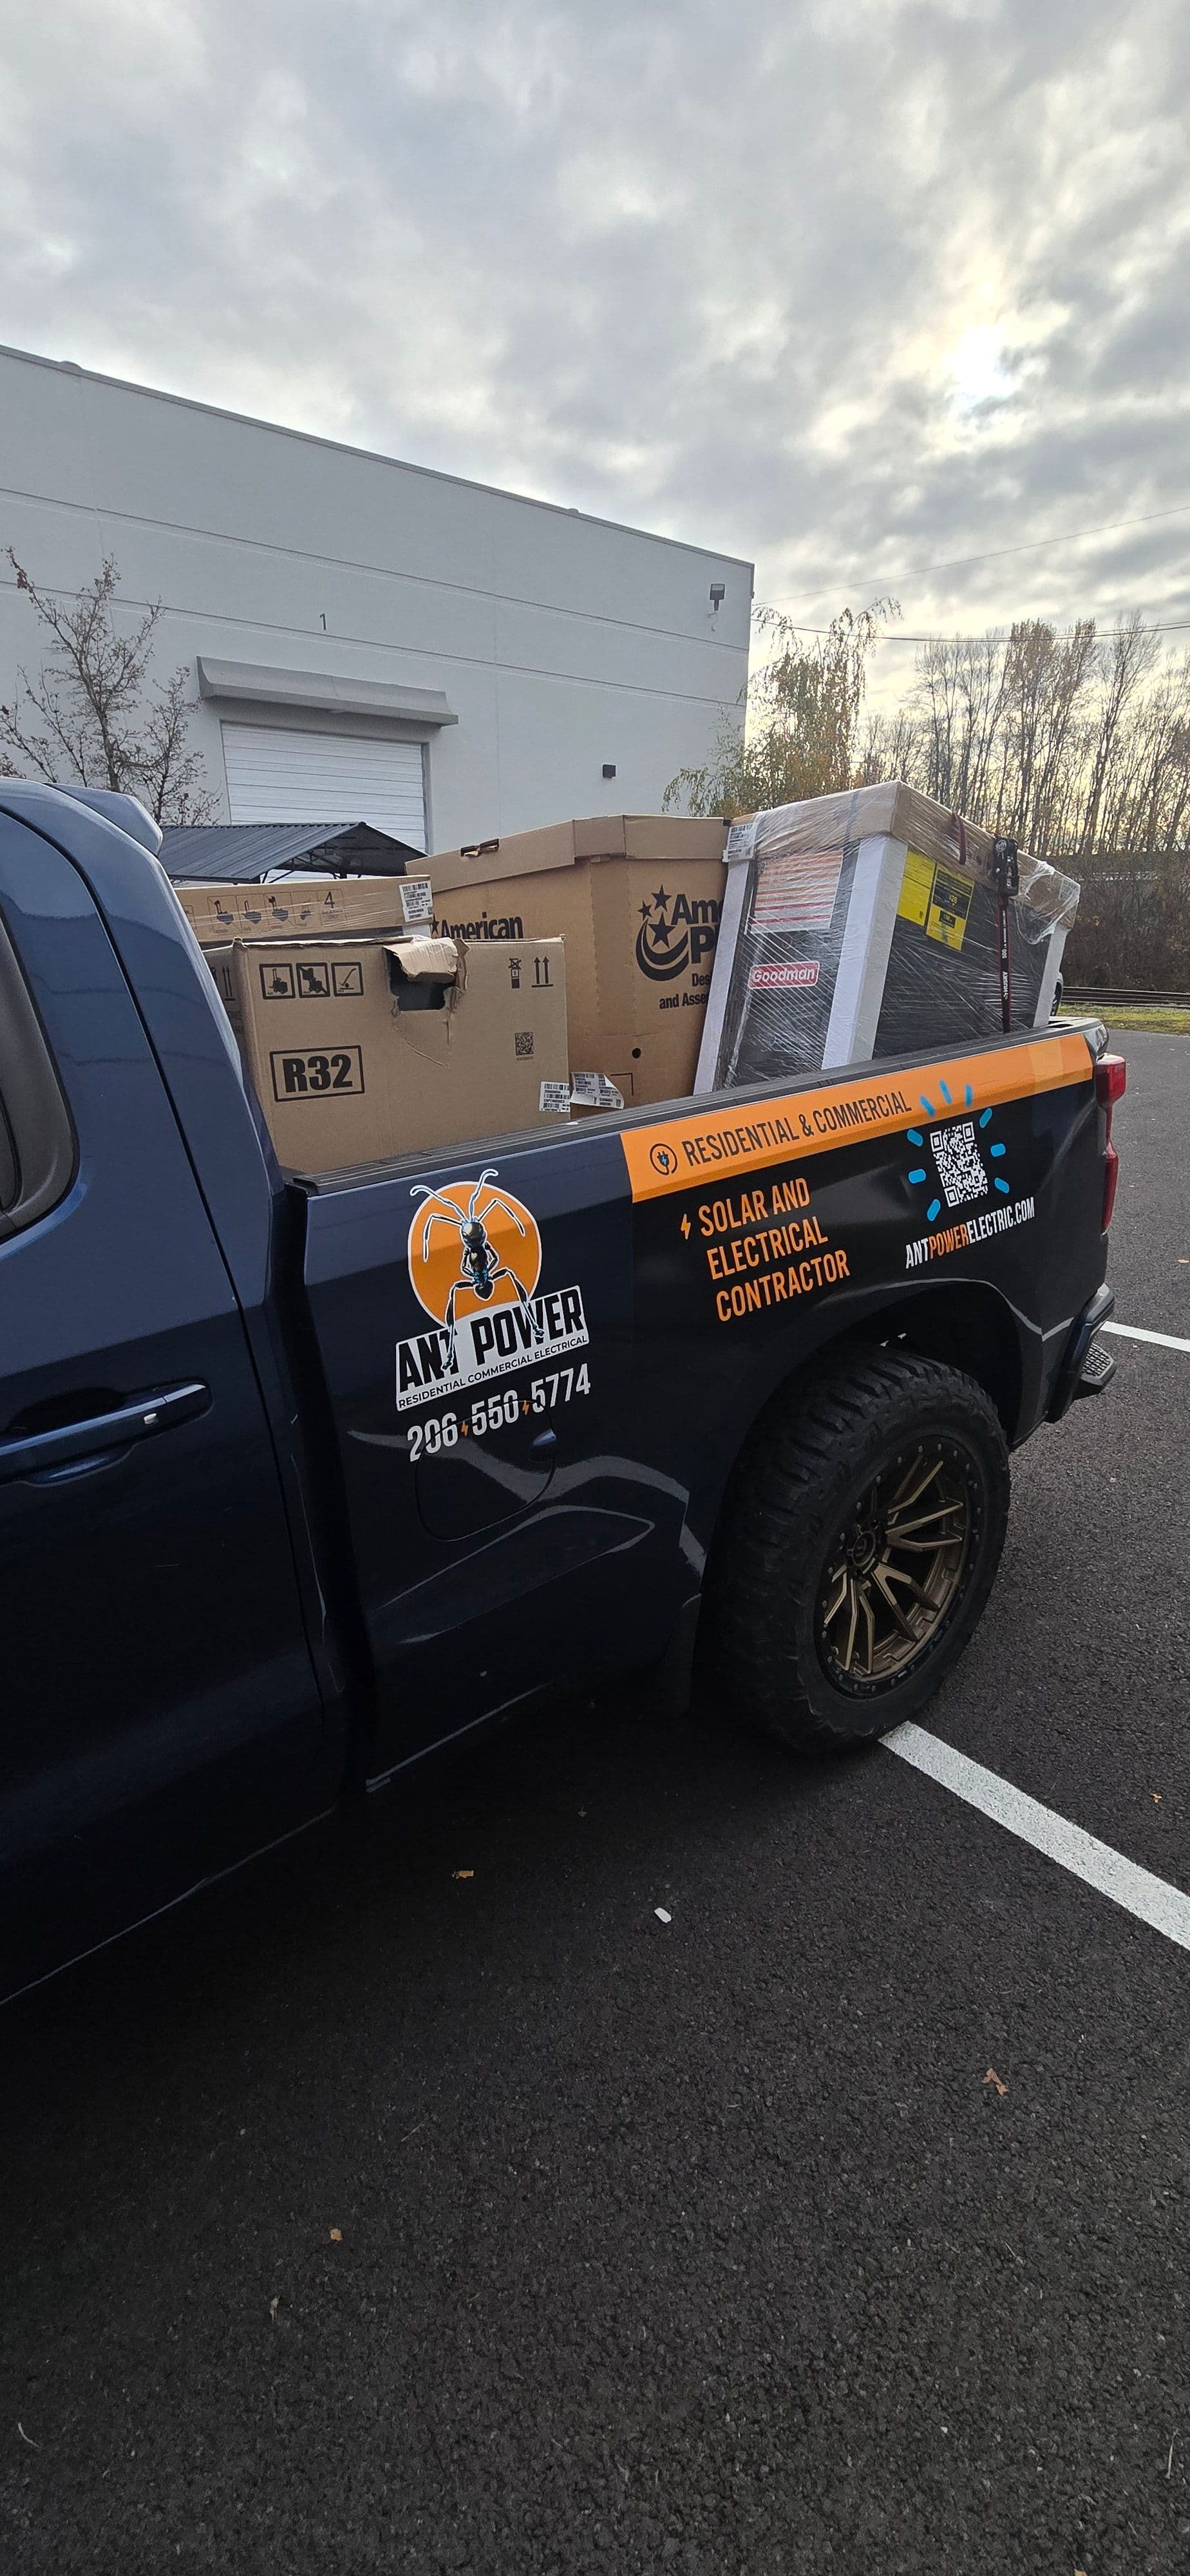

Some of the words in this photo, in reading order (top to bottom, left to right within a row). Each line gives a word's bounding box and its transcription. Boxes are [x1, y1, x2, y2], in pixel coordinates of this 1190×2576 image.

[319, 613, 326, 630] 1
[324, 891, 335, 909] 4
[441, 911, 524, 940] American
[659, 994, 679, 1010] and
[751, 968, 815, 982] Goodman
[282, 1054, 353, 1093] R32
[682, 1117, 800, 1166] RESIDENTIAL
[798, 1113, 815, 1137] &
[813, 1091, 912, 1133] COMMERCIAL
[699, 1190, 769, 1236] SOLAR
[772, 1177, 810, 1215] AND
[905, 1197, 1035, 1269] ANTPOWERELECTRIC.COM
[706, 1216, 829, 1280] ELECTRICAL
[716, 1249, 851, 1321] CONTRACTOR
[399, 1329, 460, 1393] ANT
[470, 1289, 585, 1366] POWER
[399, 1378, 466, 1408] RESIDENTIAL
[468, 1356, 533, 1383] COMMERCIAL
[534, 1334, 588, 1360] ELECTRICAL
[407, 1412, 458, 1462] 206
[471, 1390, 519, 1435] 550
[531, 1363, 591, 1413] 5774
